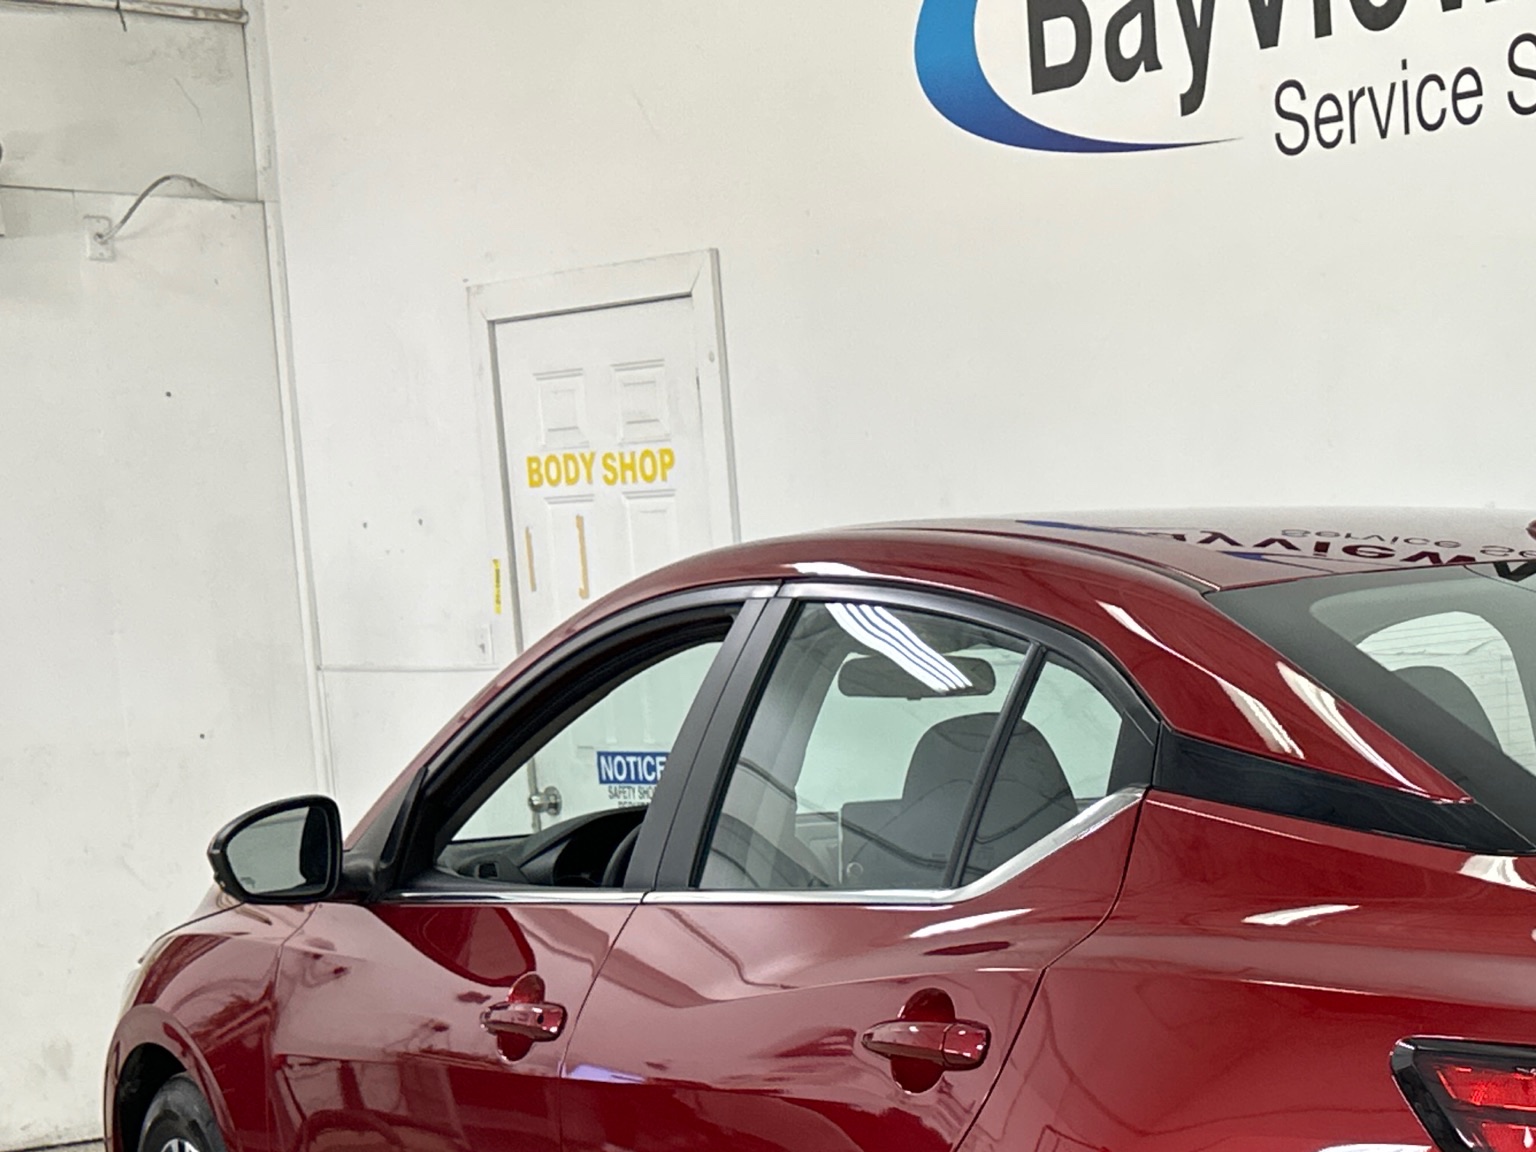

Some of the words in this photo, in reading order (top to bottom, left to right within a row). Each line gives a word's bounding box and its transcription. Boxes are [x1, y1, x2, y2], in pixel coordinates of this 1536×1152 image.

[1274, 59, 1484, 156] Service
[526, 452, 596, 488] BODY
[602, 448, 675, 486] SHOP
[608, 785, 635, 800] SAFETY
